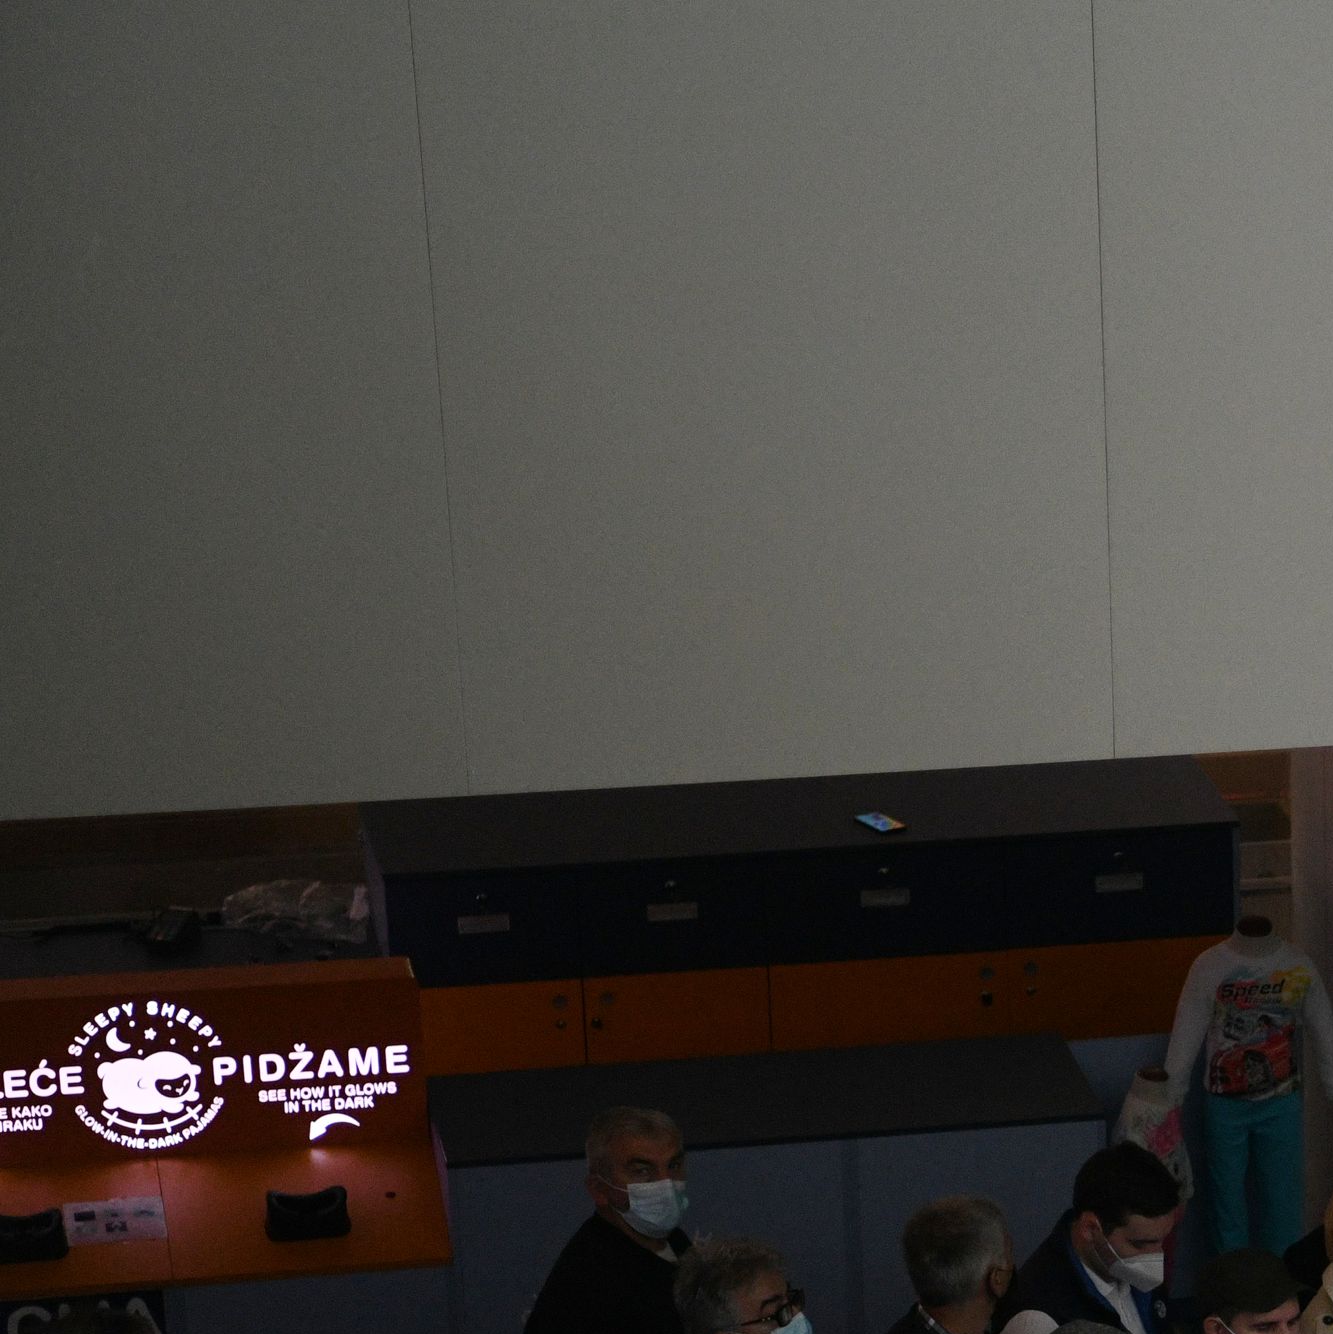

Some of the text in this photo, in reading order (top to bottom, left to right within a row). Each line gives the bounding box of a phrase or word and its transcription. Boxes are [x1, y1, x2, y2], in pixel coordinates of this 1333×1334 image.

[1221, 979, 1285, 1001] Speed
[67, 1000, 222, 1056] SLEEPY SHEEPY
[0, 1043, 410, 1098] EĆE PIDŽAME
[258, 1081, 397, 1103] SEE HOW IT GLOWS
[11, 1104, 53, 1119] KAKO
[284, 1096, 375, 1114] IN THE DARK
[0, 1118, 43, 1133] RAKU
[182, 1096, 224, 1140] PAJAMAS
